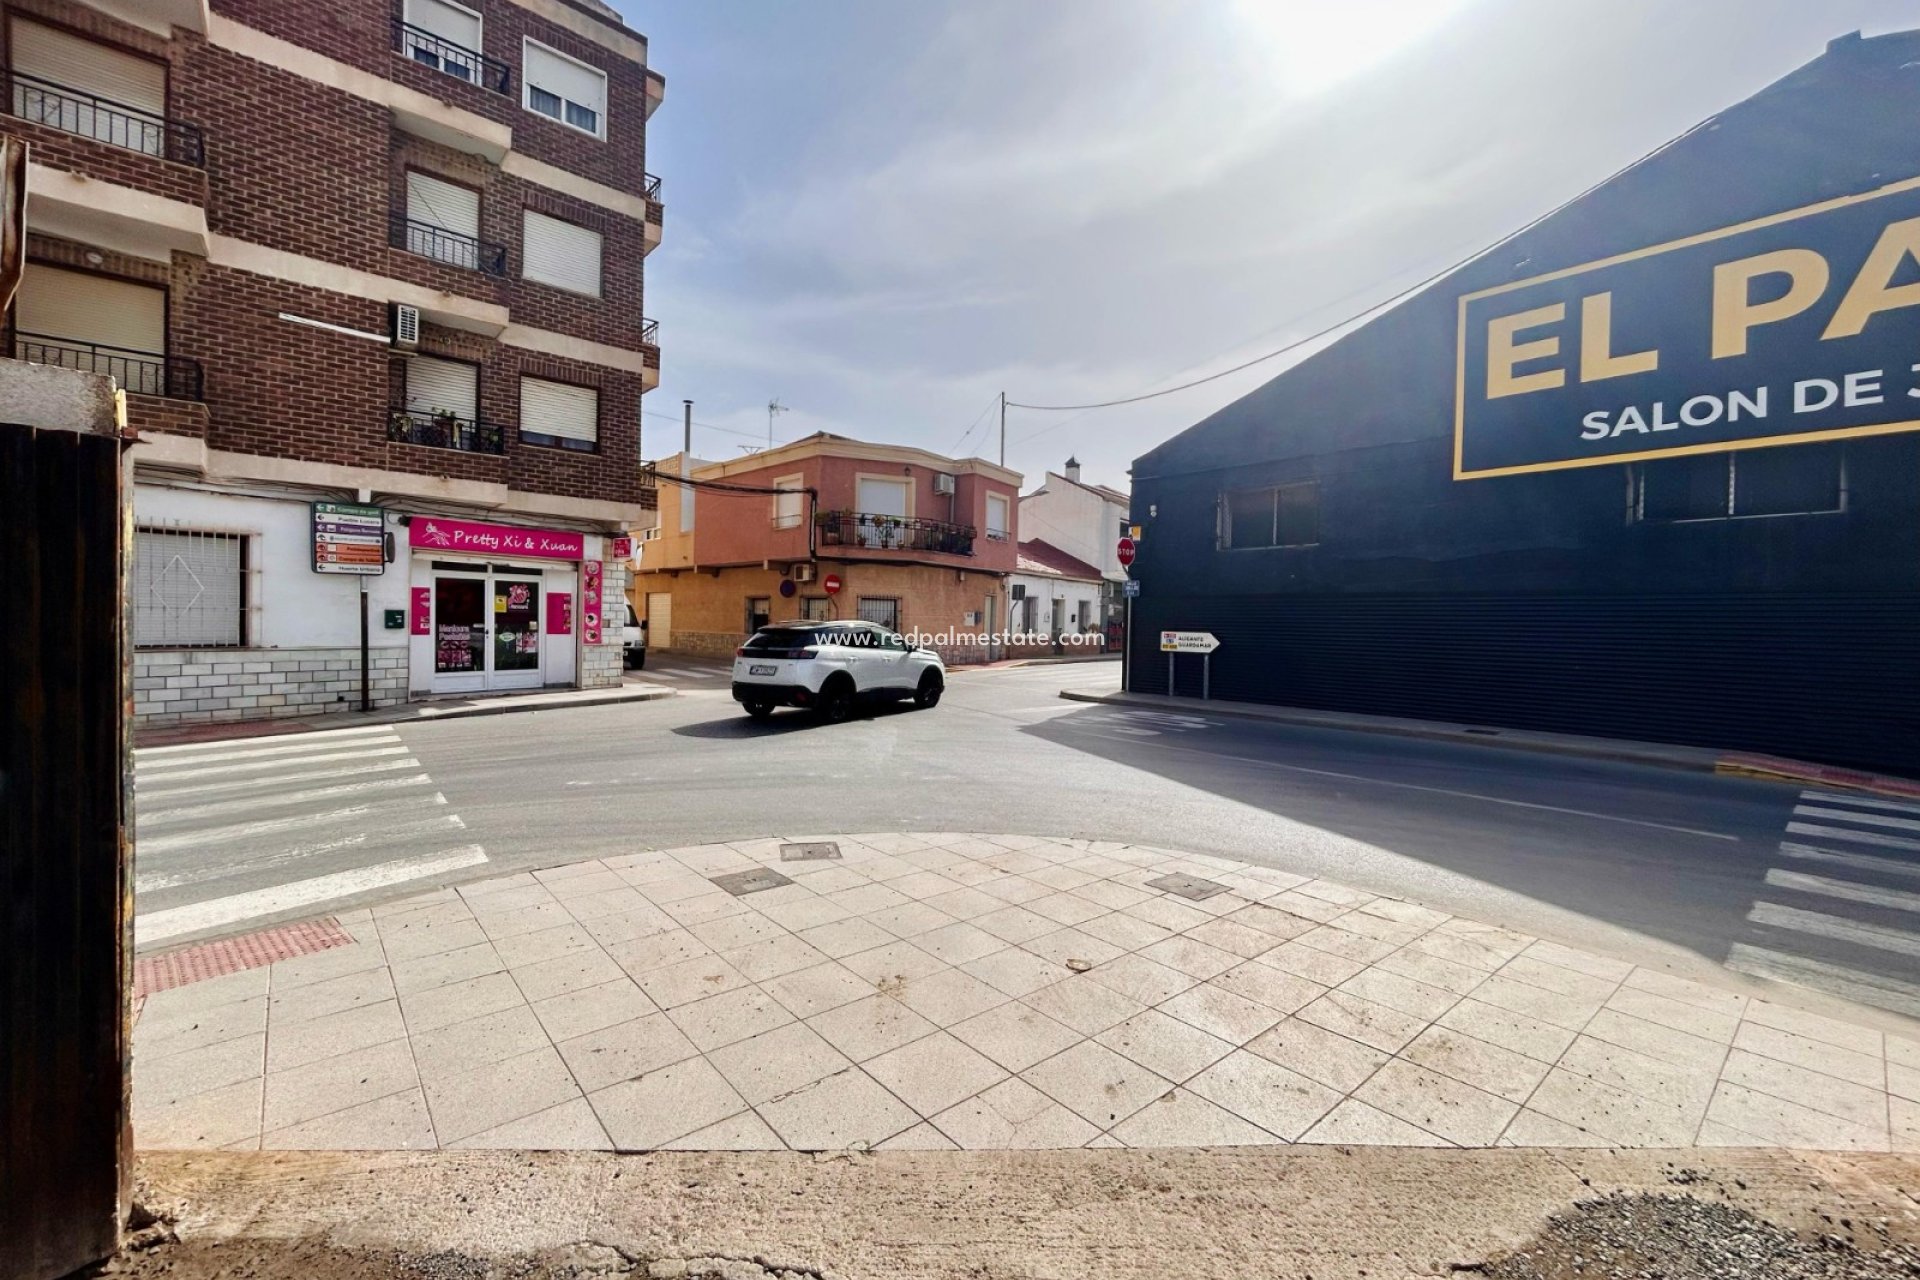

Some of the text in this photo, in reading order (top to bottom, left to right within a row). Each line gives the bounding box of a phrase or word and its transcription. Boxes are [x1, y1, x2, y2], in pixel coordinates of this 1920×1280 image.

[1487, 291, 1658, 399] EL
[1580, 386, 1767, 440] SALON
[1794, 369, 1884, 413] DE
[454, 530, 578, 552] Pretty Xi & Xuan
[1118, 548, 1134, 556] STOP
